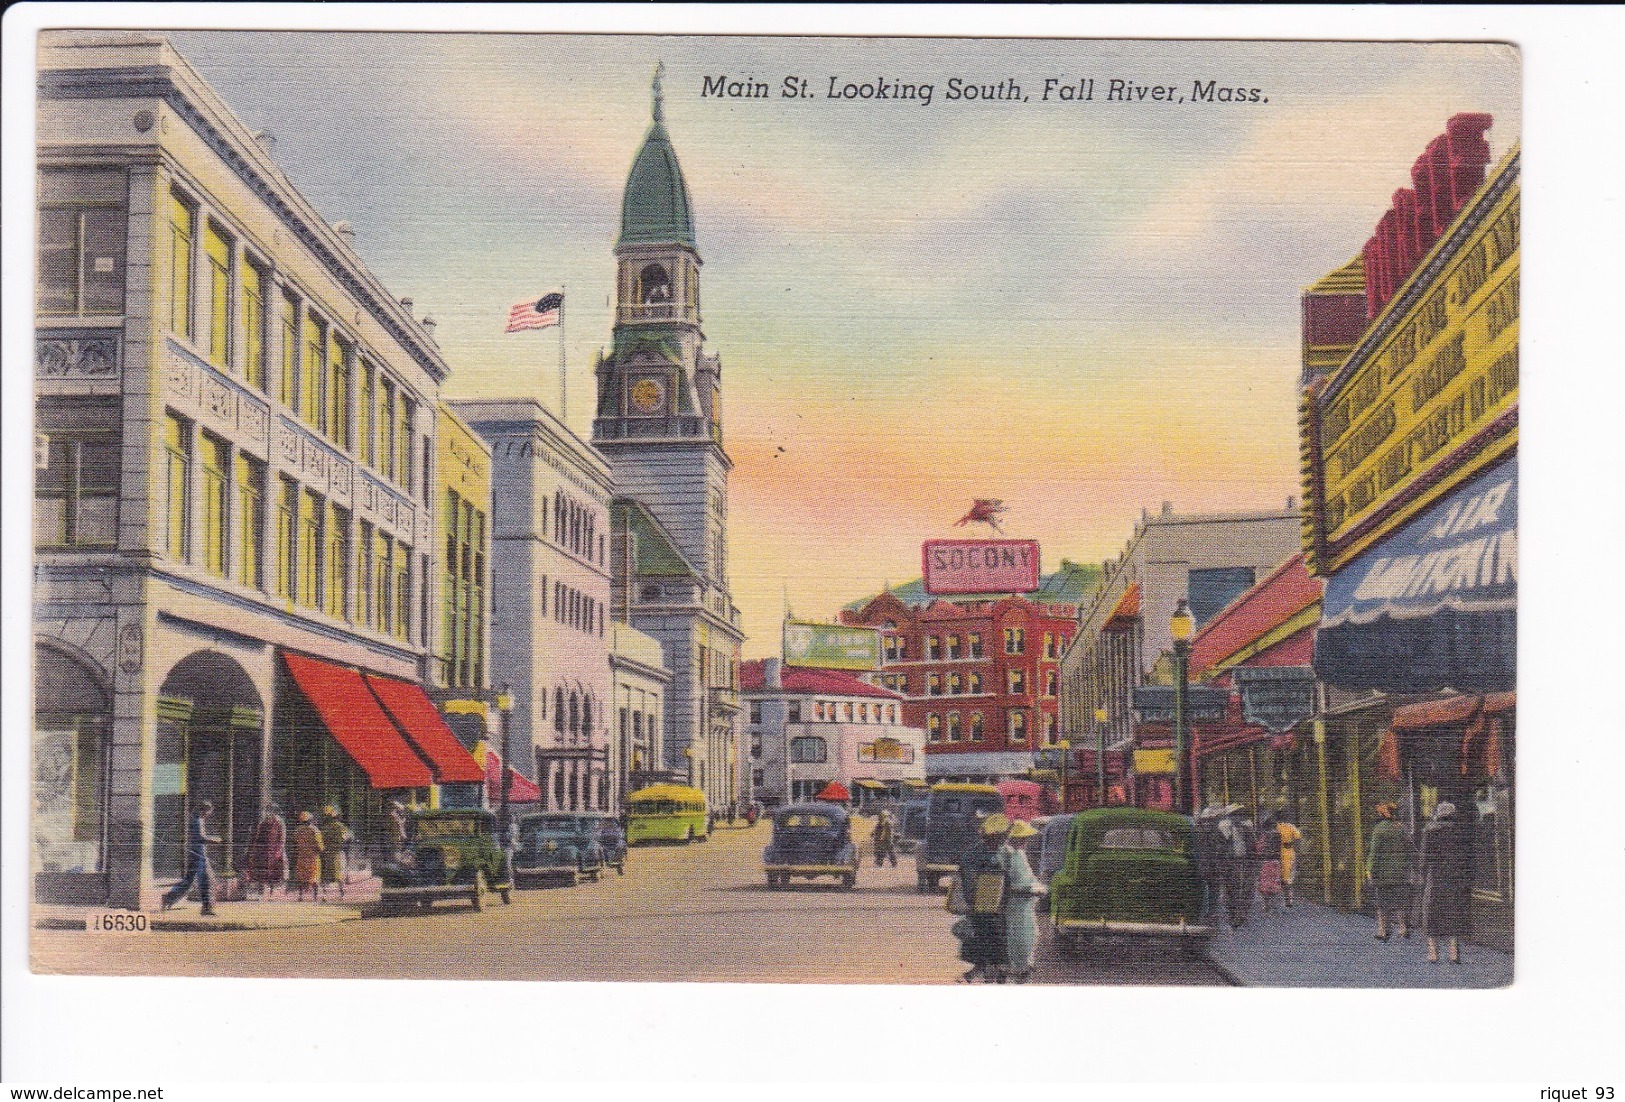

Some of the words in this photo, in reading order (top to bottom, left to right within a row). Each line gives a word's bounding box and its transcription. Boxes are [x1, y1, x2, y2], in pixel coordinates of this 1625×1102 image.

[700, 72, 769, 98] Main
[780, 75, 815, 99] St.
[826, 76, 935, 107] Looking
[945, 77, 1029, 103] South,
[1042, 78, 1094, 101] Fall
[1106, 78, 1184, 104] River,
[1190, 80, 1269, 104] Mass.
[933, 546, 1030, 570] SOCONY
